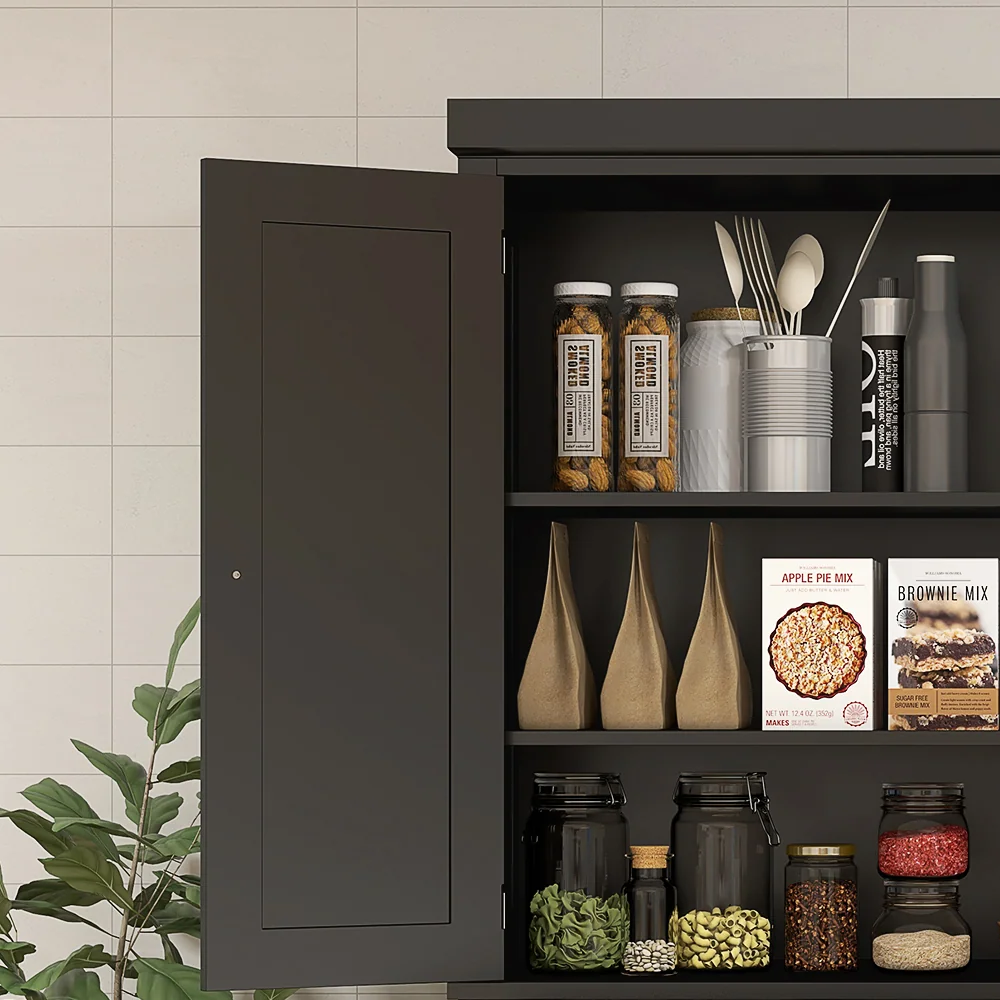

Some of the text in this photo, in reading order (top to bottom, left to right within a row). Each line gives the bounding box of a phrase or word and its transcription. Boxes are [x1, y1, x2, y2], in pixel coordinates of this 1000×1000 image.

[781, 573, 853, 583] APPLE PIE MIX
[898, 585, 988, 601] BROWNIE MIX
[816, 710, 834, 719] (352g)
